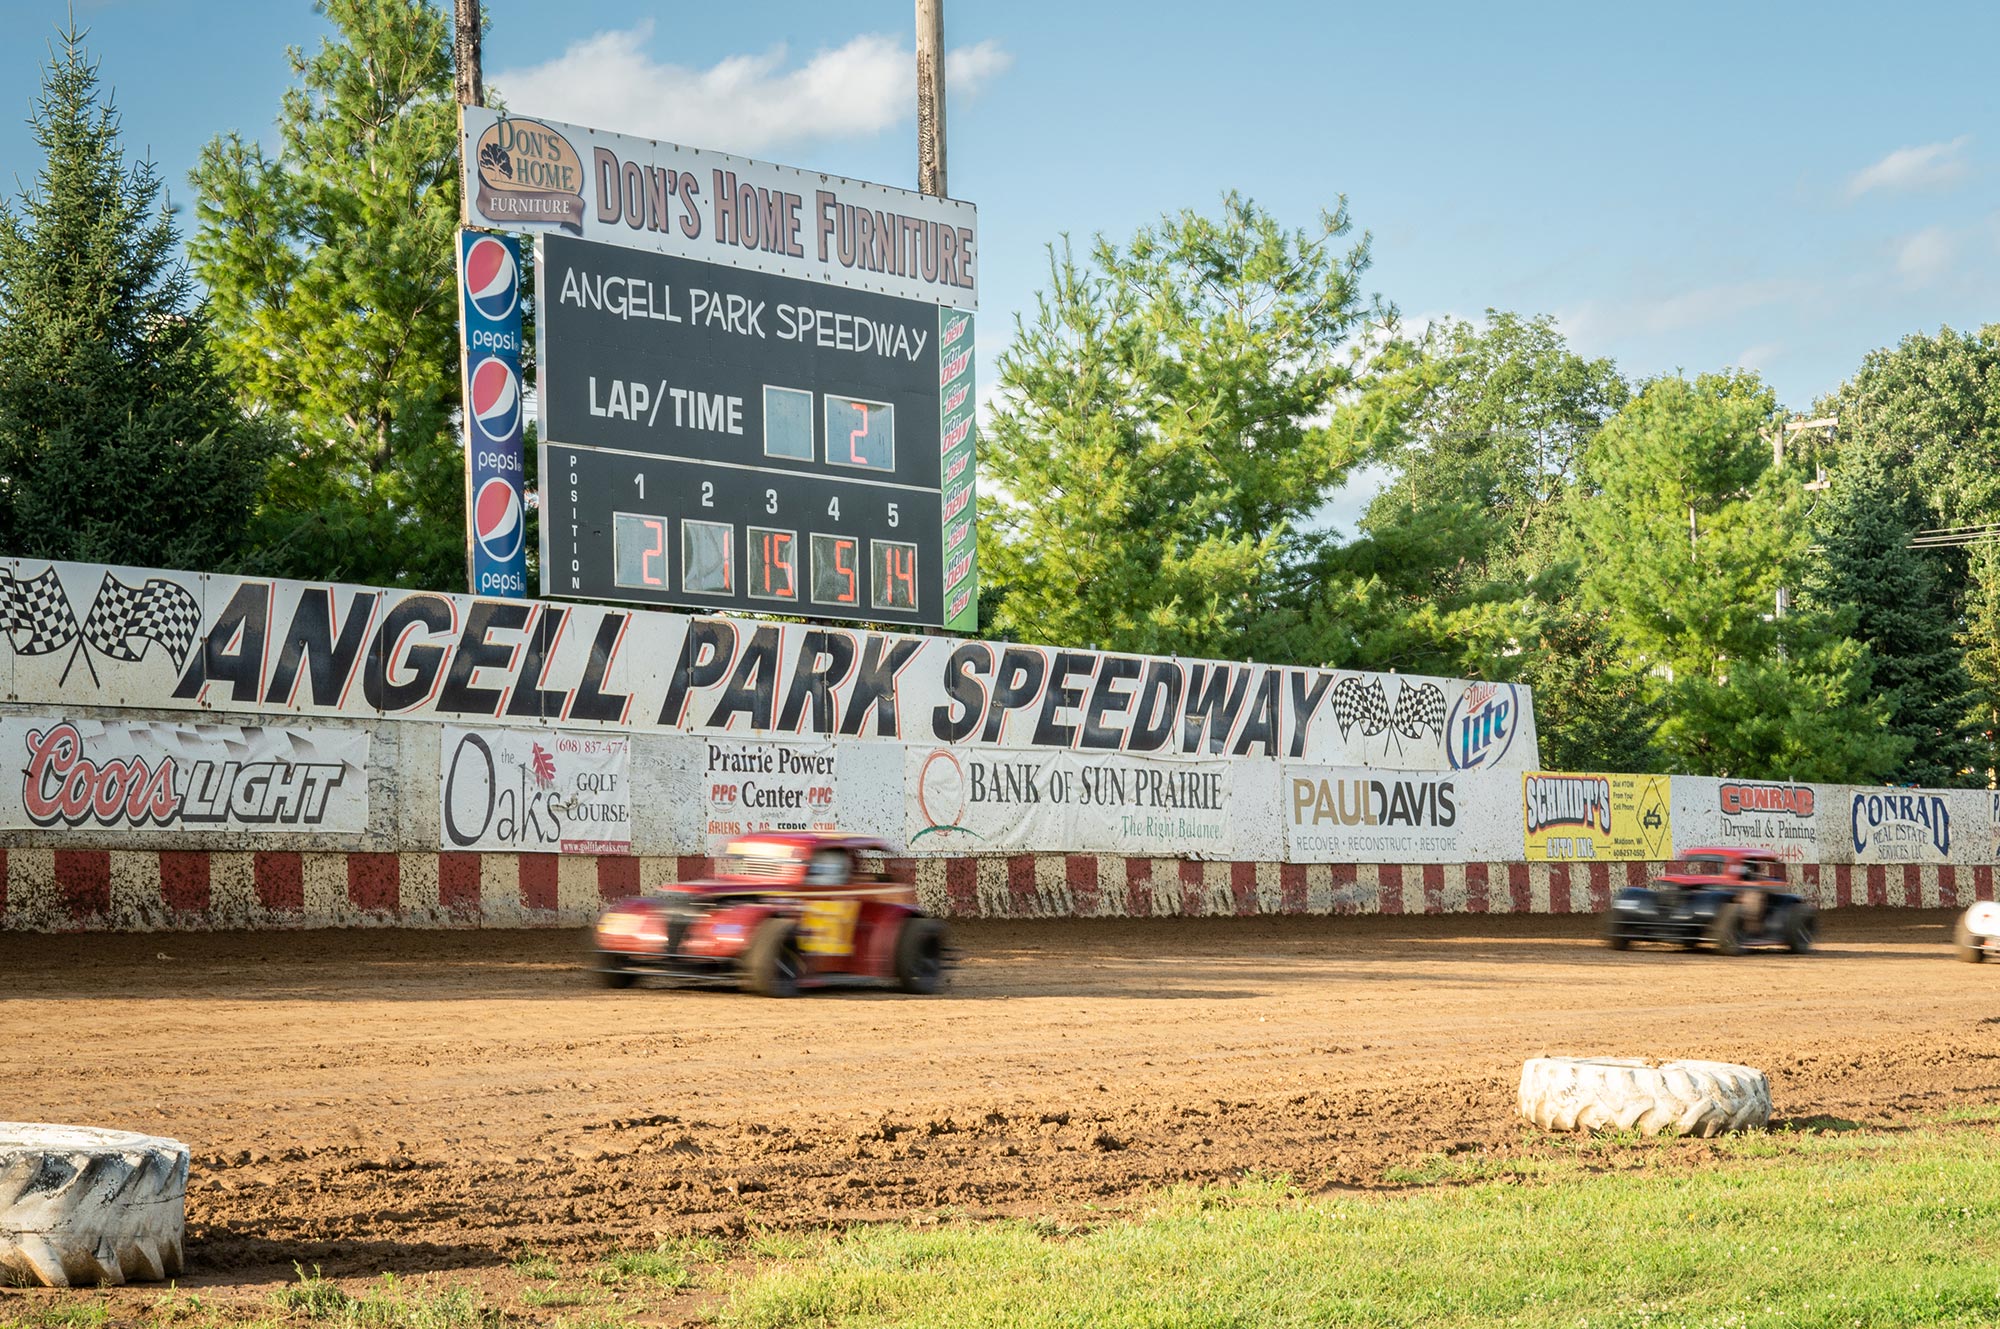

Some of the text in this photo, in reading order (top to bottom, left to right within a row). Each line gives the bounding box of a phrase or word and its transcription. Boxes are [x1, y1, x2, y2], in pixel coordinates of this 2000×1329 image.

[496, 116, 561, 161] DON'S
[516, 158, 576, 191] HOME
[490, 197, 571, 215] FURNITURE
[593, 145, 975, 291] DON'S HOME FURNITURE
[560, 266, 928, 362] ANGELL PARK SPEEDWAY
[589, 376, 744, 435] LAP/TIME
[849, 401, 869, 465] 2
[633, 473, 899, 527] 1 2 3 4 5
[569, 455, 580, 589] POSITION
[642, 520, 914, 605] 2 1 15 5 14
[171, 581, 1339, 760] ANGELL PARK SPEEDWAY
[1464, 681, 1498, 709] Miller
[556, 738, 581, 754] (608)
[1461, 699, 1509, 769] Lite
[501, 748, 515, 764] the
[708, 744, 834, 775] Prairie Power
[22, 722, 346, 827] Coors LIGHT
[444, 732, 561, 847] Oaks
[576, 772, 618, 792] GOLF
[969, 762, 1223, 810] BANK OF SUN PRAIRIE
[711, 784, 737, 802] PPC
[741, 780, 804, 808] Center
[808, 787, 833, 804] PPC
[1525, 776, 1612, 837] SCHMIDT'S
[1613, 803, 1635, 811] Cell Phone
[1720, 782, 1815, 818] CONRAD
[566, 803, 627, 822] COURSE
[708, 820, 741, 835] ARIENS
[1852, 793, 1950, 857] CONRAD
[1121, 815, 1223, 842] The Right Balance.
[1296, 836, 1457, 852] RECOVER RECONSTRUCT RESTORE
[1723, 817, 1816, 843] Drywall & Painting
[1873, 824, 1929, 845] REAL ESTATE
[1547, 837, 1597, 859] AUTO INC.
[1911, 844, 1924, 859] LLC
